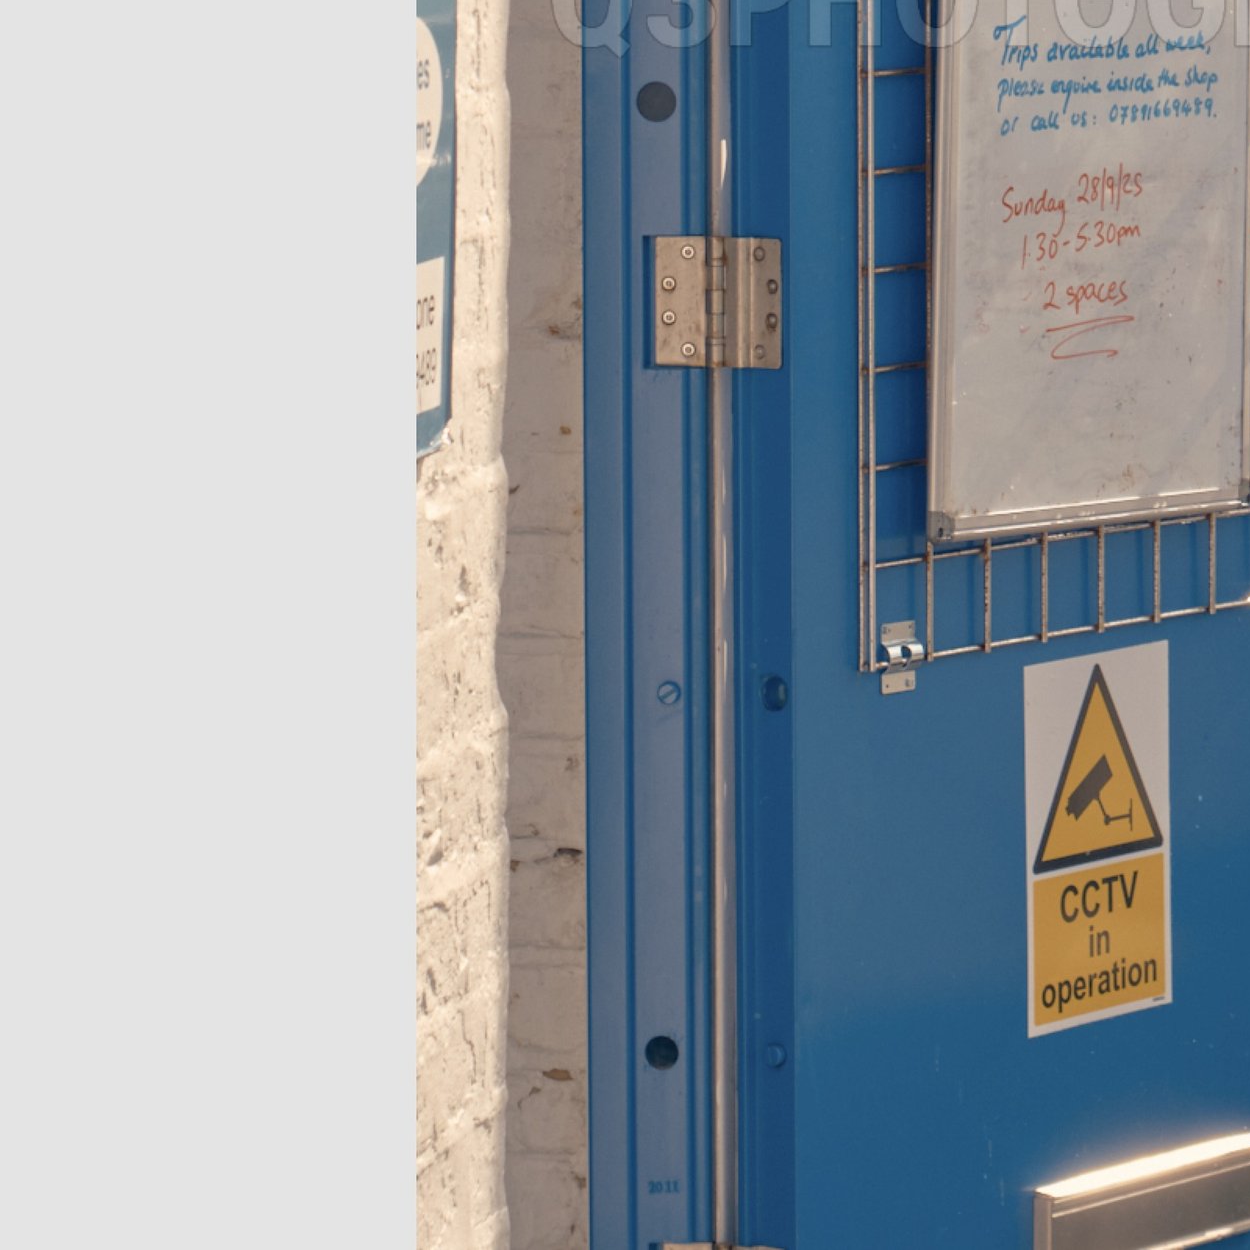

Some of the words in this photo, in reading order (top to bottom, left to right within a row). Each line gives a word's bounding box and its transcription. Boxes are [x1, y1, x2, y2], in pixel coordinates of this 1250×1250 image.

[993, 14, 1039, 71] Trips
[1047, 35, 1130, 63] available
[1135, 33, 1159, 58] all
[997, 78, 1045, 112] please
[1107, 70, 1154, 93] inside
[1158, 67, 1180, 88] the
[1000, 116, 1019, 136] or
[1030, 110, 1060, 131] call
[1002, 186, 1066, 238] Sunday
[1077, 162, 1143, 211] 28/9/25
[1043, 281, 1061, 310] 2
[1066, 280, 1128, 314] spaces
[1060, 870, 1138, 924] CCTV
[1089, 925, 1111, 958] in
[1041, 957, 1158, 1014] operation
